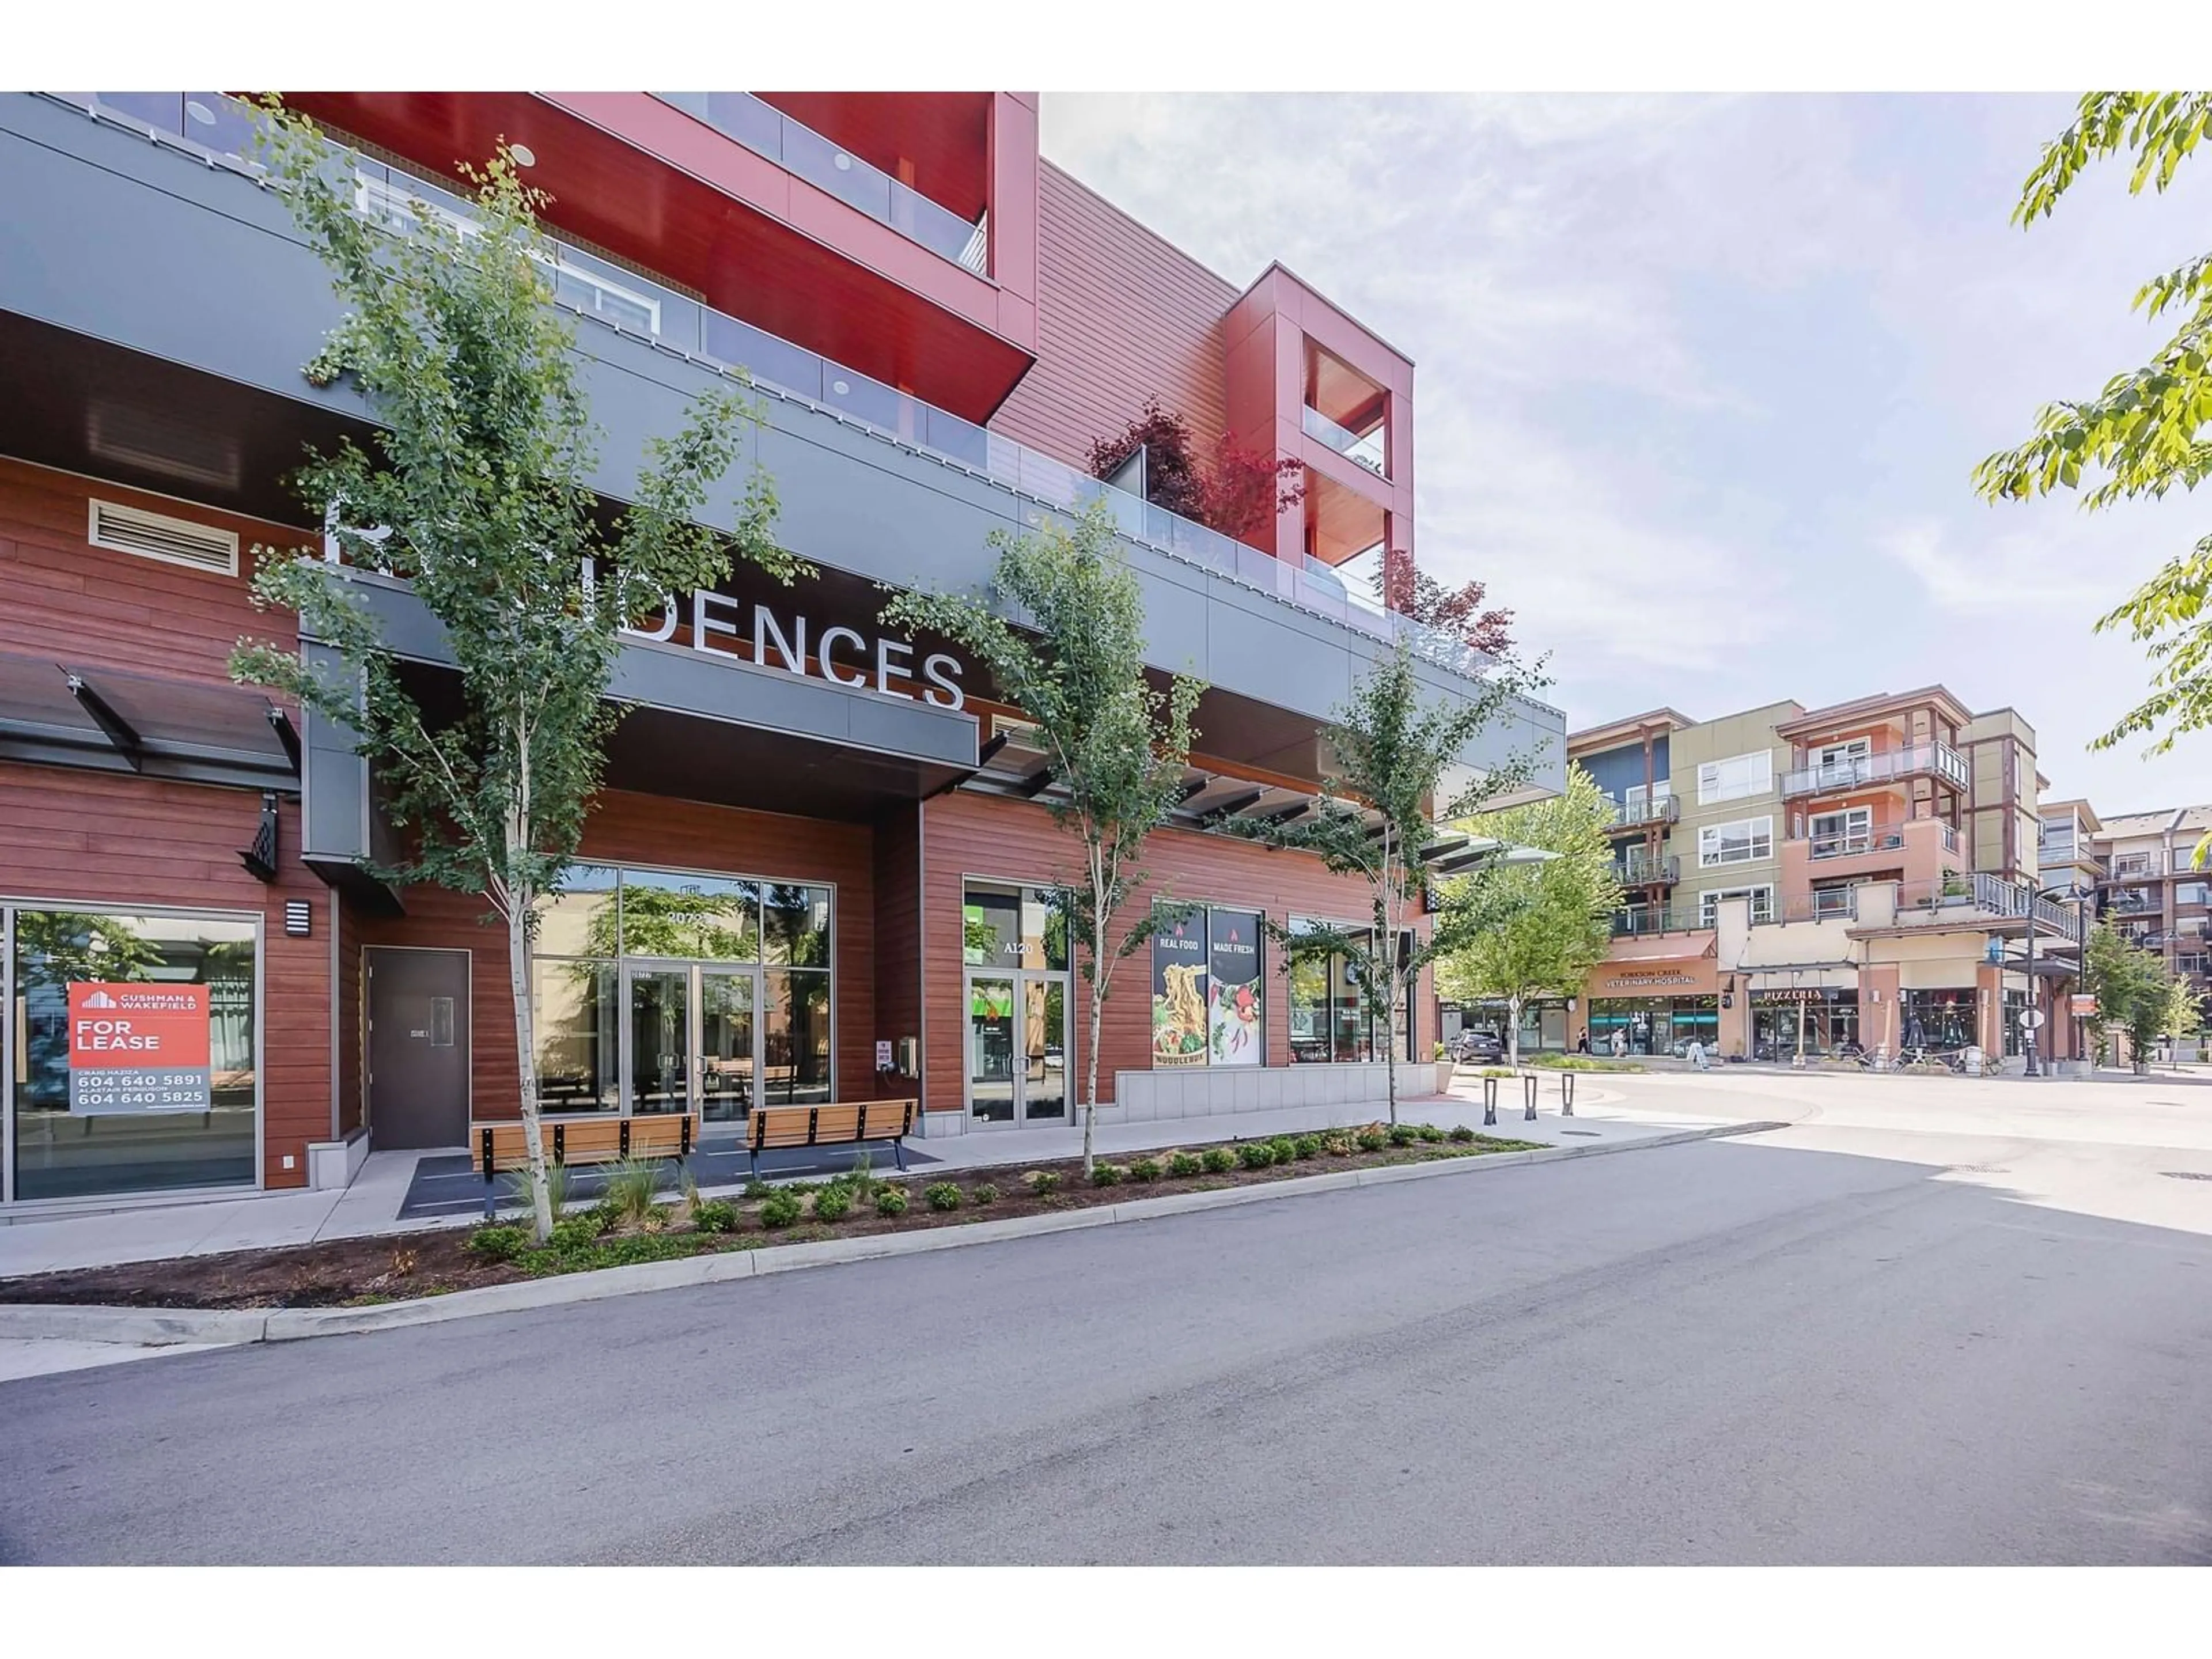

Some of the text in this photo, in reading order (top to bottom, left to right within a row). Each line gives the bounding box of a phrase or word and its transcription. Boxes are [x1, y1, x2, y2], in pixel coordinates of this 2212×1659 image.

[1004, 942, 1033, 954] A120
[1160, 938, 1198, 950] REAL FOOD
[1213, 942, 1255, 955] MADE FRESH
[1606, 975, 1695, 988] VETERINARY HOSPITAL
[1764, 990, 1823, 1000] PIZZERIA
[77, 1020, 132, 1035] FOR
[77, 1036, 160, 1050] LEASE
[78, 1075, 202, 1087] 604 640 5891
[78, 1092, 203, 1104] 604 640 5825
